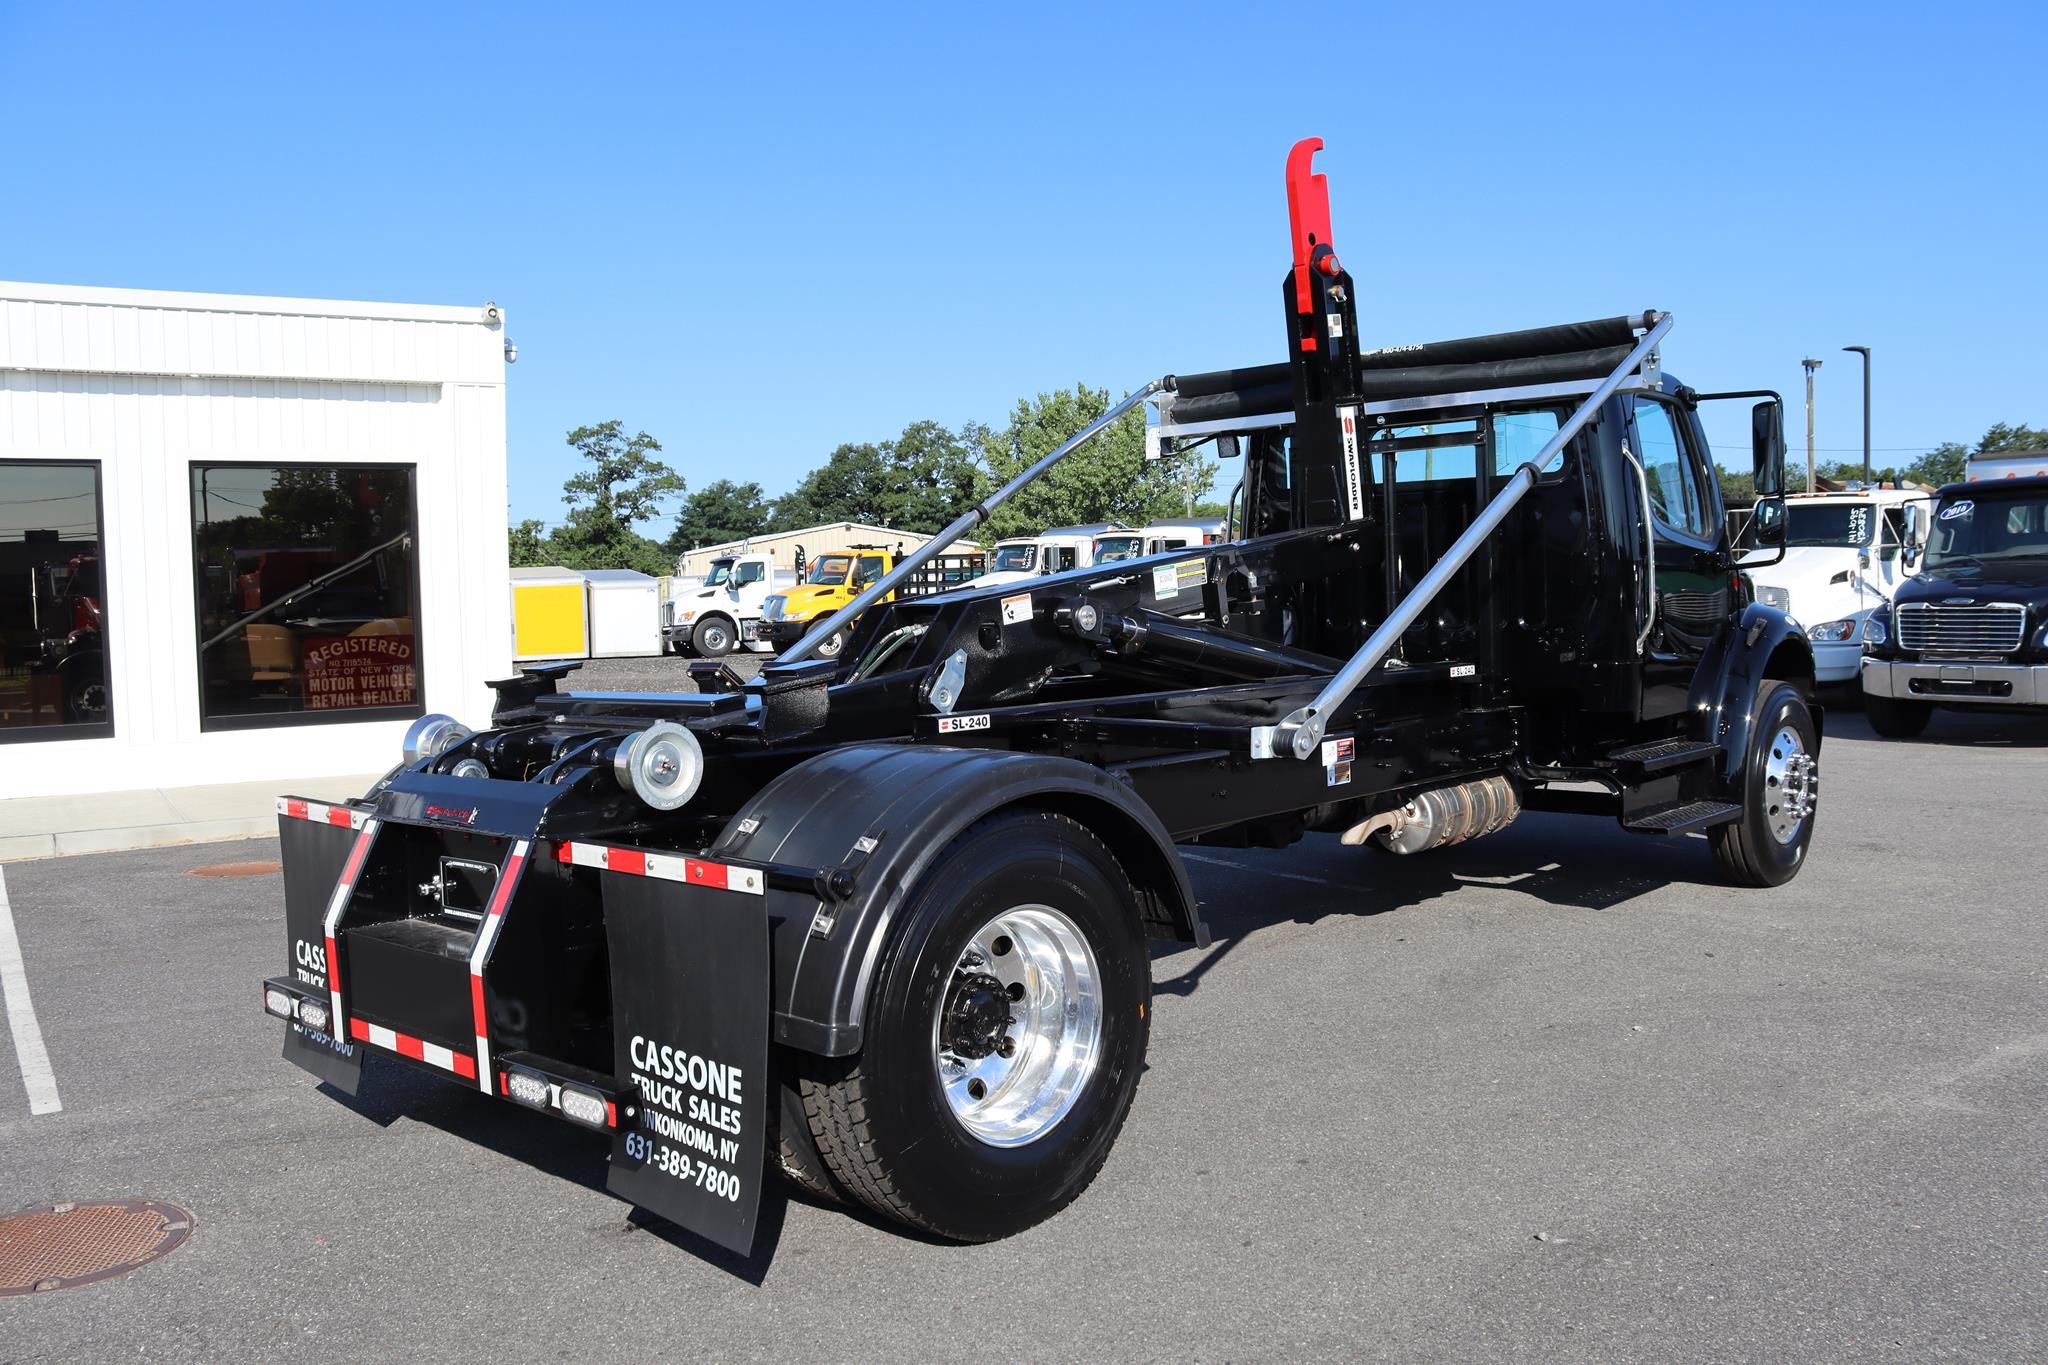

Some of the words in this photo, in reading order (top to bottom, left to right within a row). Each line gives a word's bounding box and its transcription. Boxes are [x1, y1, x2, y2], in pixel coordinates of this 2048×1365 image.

[1346, 437, 1359, 511] SWAPLOADER
[309, 638, 410, 665] REGISTERED
[308, 668, 340, 677] STATE
[343, 667, 355, 675] OF
[360, 665, 382, 674] NEW
[386, 664, 412, 673] YORK
[309, 676, 355, 692] MOTOR
[360, 673, 414, 689] VEHICLE
[312, 692, 358, 708] RETAIL
[362, 689, 411, 705] DEALER
[951, 716, 988, 730] SL-240
[630, 1035, 743, 1104] CASSONE
[631, 1072, 683, 1114] TRUCK
[688, 1094, 741, 1135] SALES
[720, 1137, 740, 1165] NY
[626, 1132, 741, 1202] 631-389-7800
